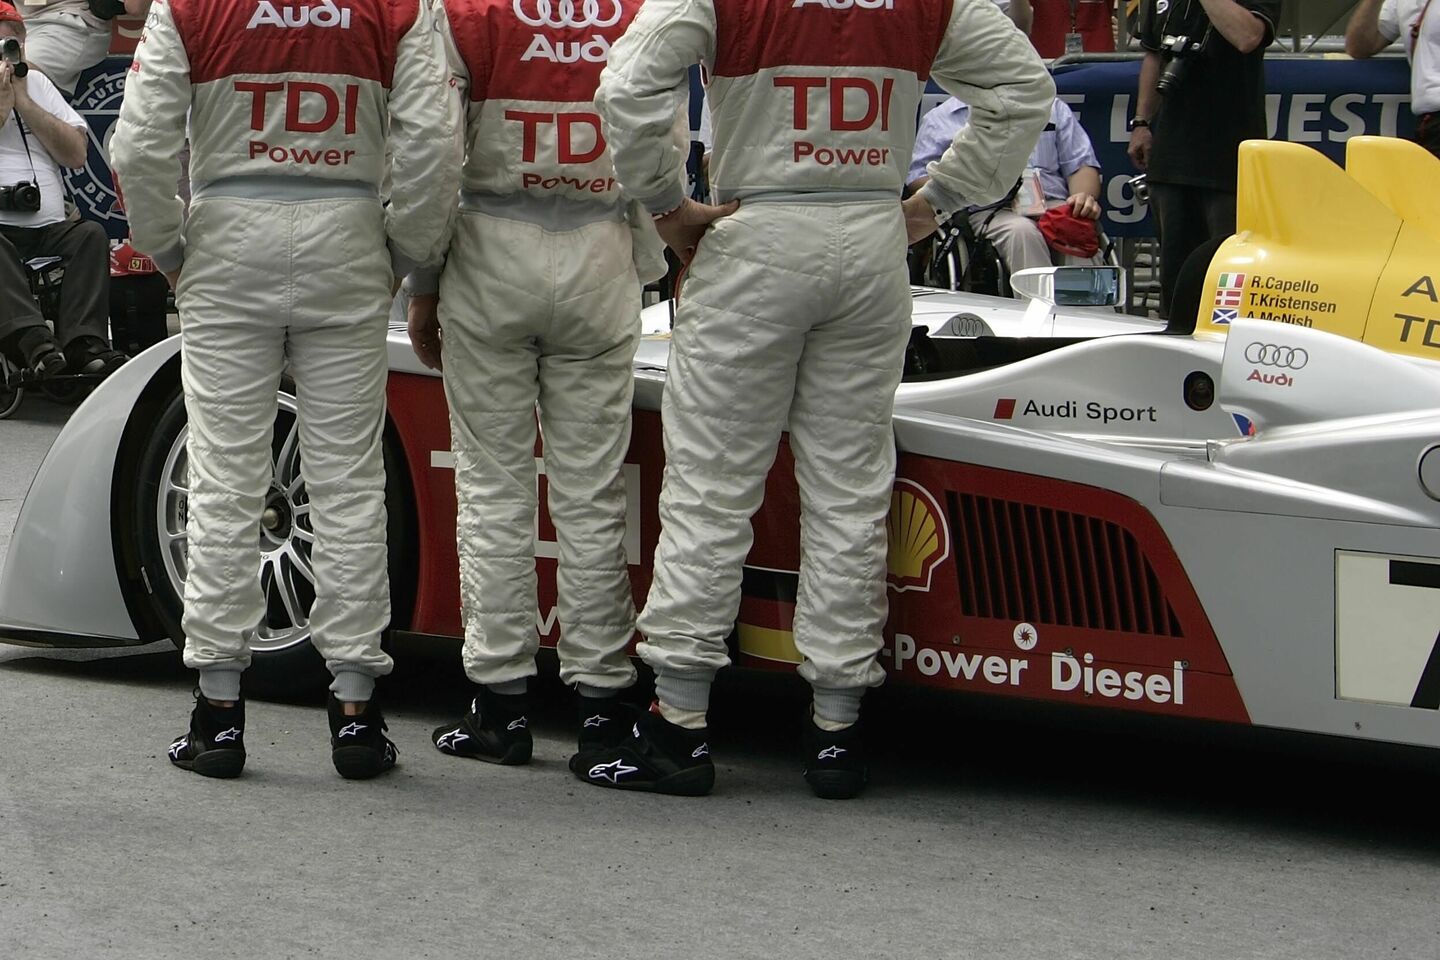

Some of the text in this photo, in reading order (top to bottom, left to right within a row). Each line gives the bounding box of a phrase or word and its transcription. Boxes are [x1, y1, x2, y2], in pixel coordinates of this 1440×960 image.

[246, 0, 351, 30] Audi
[521, 33, 611, 64] Aud
[234, 81, 357, 135] TDI
[774, 76, 895, 132] TDI
[505, 110, 606, 164] TD
[248, 140, 356, 167] Power
[793, 141, 890, 166] Power
[84, 181, 106, 203] DE
[1250, 275, 1319, 294] R.Capello
[1249, 292, 1337, 314] T.Kristensen
[1247, 310, 1313, 329] AMcNish
[1246, 369, 1293, 387] Audi
[1023, 399, 1157, 424] Audi Sport
[1051, 651, 1184, 705] Diesel
